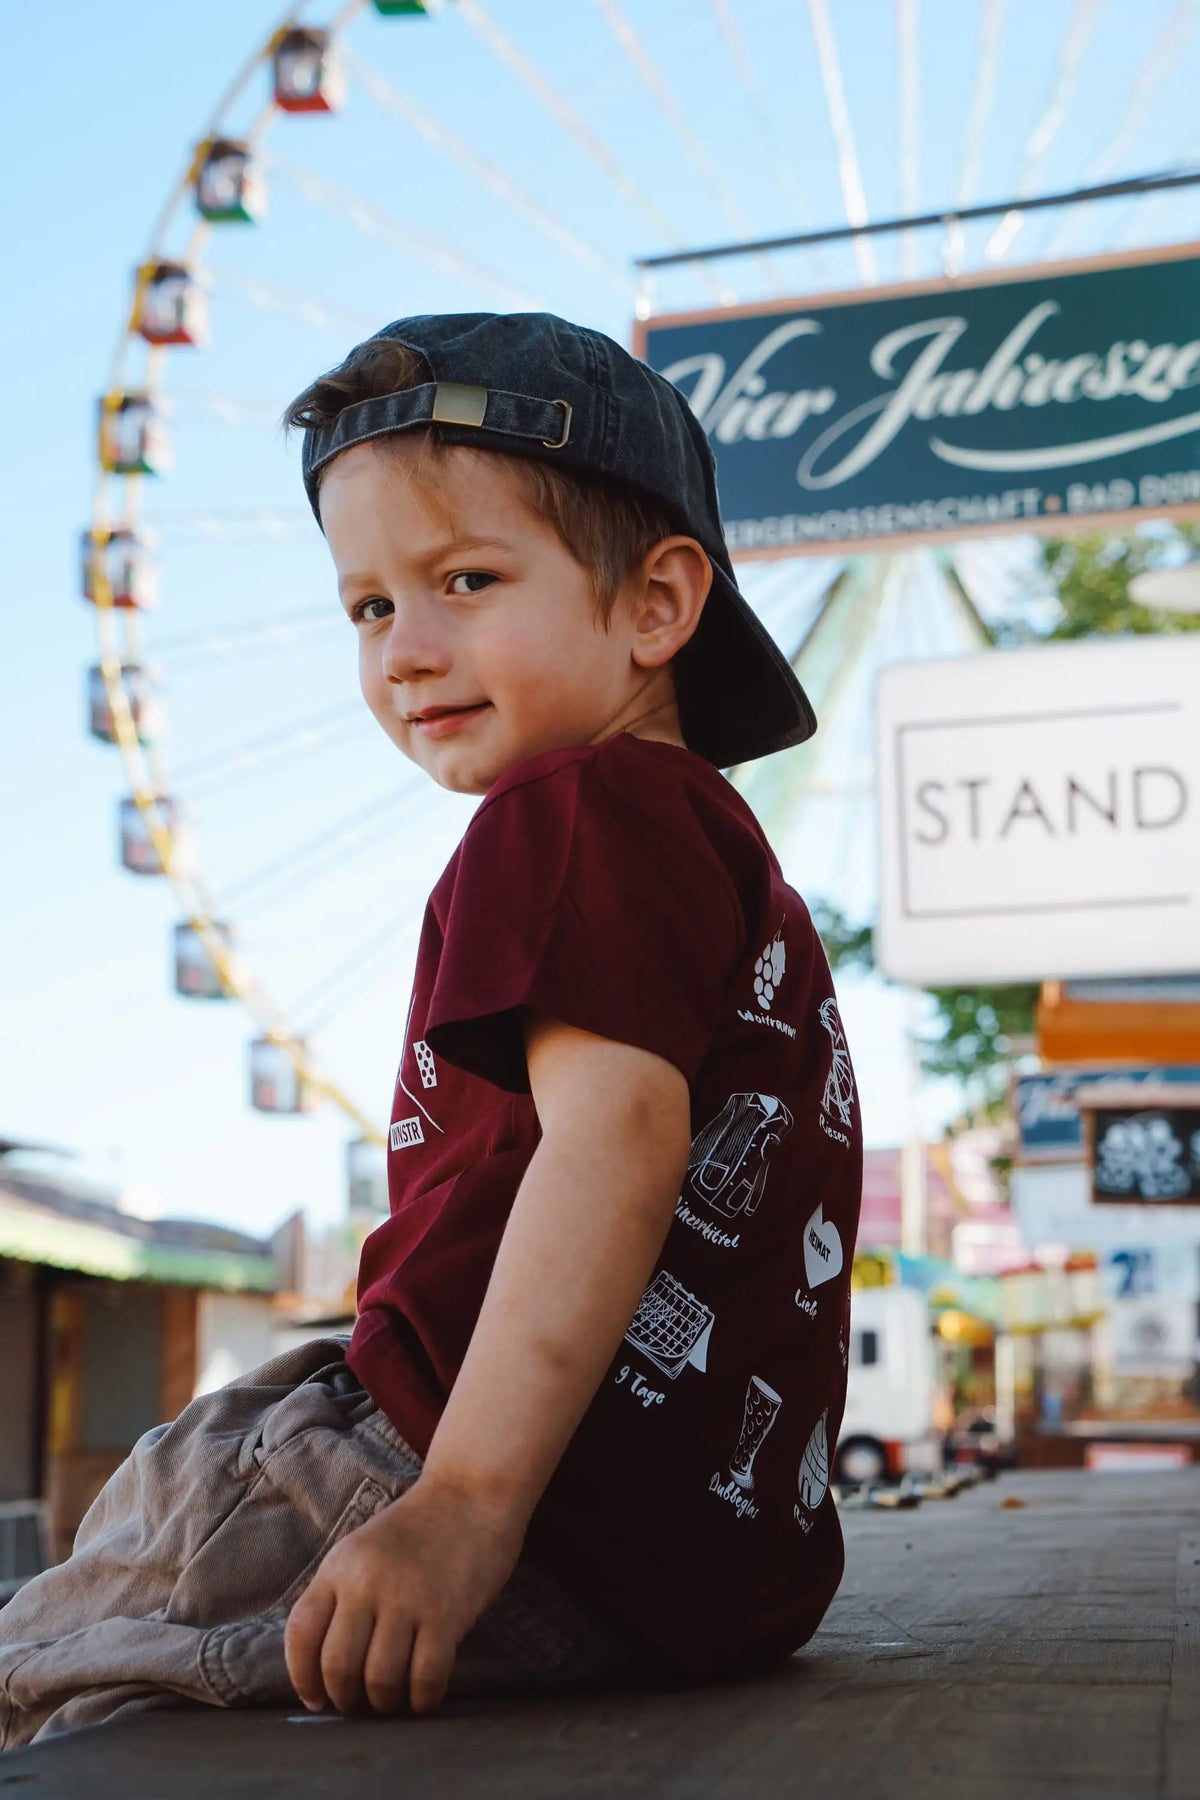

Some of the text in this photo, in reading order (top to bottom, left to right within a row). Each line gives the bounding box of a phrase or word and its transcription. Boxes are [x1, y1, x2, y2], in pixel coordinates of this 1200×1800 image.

[660, 317, 836, 445] Vier
[723, 488, 1042, 549] ERGENOSSENSCHAFT
[915, 763, 1189, 845] STAND
[674, 1195, 740, 1248] inzerkittel
[808, 1227, 831, 1263] HEIMAT
[614, 1365, 665, 1407] 9 Tage
